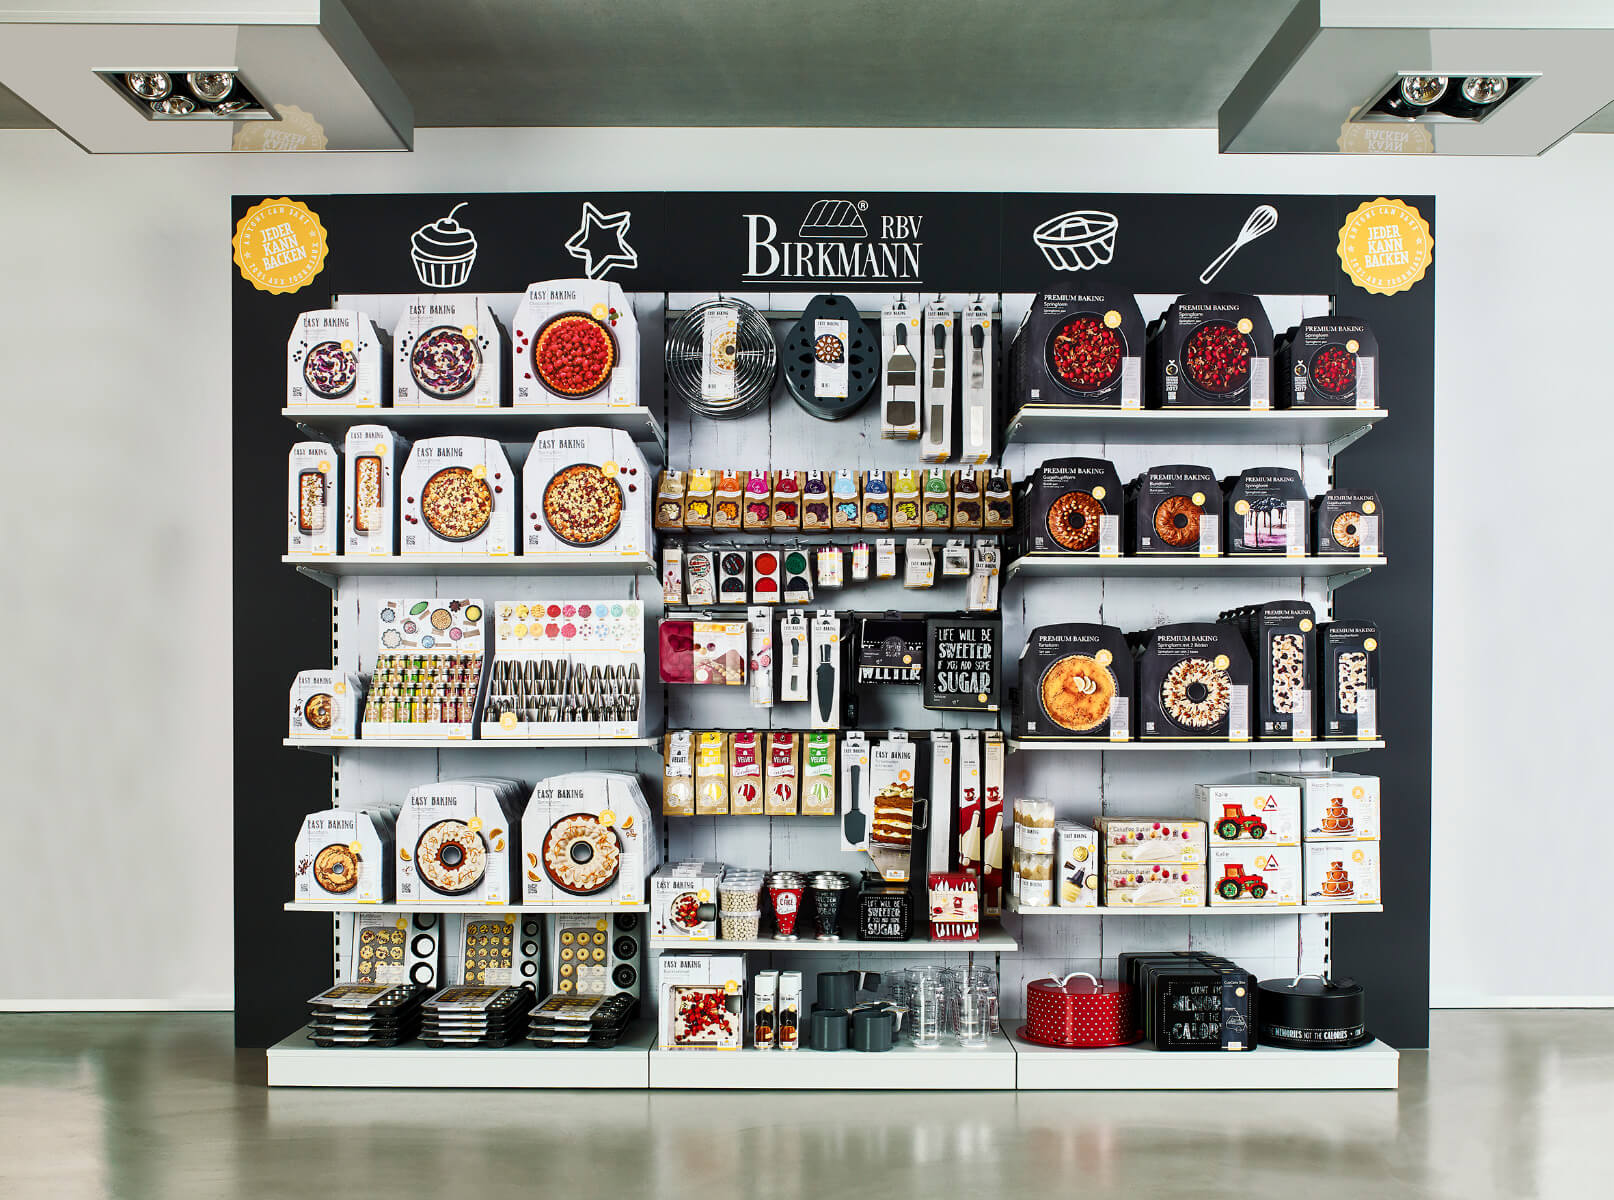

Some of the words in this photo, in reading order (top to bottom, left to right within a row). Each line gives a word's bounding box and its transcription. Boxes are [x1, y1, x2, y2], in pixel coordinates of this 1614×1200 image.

[880, 215, 923, 239] RBV
[260, 222, 294, 243] JEDER
[1367, 224, 1401, 241] JEDER
[262, 233, 299, 256] KANN
[741, 213, 924, 279] BIRKMANN
[1367, 237, 1404, 255] KANN
[262, 245, 307, 271] BACKEN
[1364, 250, 1409, 268] BACKEN
[529, 290, 547, 301] EASY
[550, 290, 577, 301] BAKING
[1043, 294, 1078, 302] PREMIUM
[409, 305, 425, 315] EASY
[429, 305, 456, 315] BAKING
[303, 318, 320, 328] EASY
[323, 317, 350, 328] BAKING
[538, 440, 556, 449] EASY
[559, 440, 585, 449] BAKING
[416, 447, 433, 457] EASY
[437, 447, 463, 457] BAKING
[1043, 467, 1076, 475] PREMIUM
[1077, 467, 1105, 475] BAKING
[938, 628, 955, 641] LIFE
[959, 628, 977, 641] WILL
[981, 628, 993, 641] BE
[1039, 635, 1072, 643] PREMIUM
[1072, 635, 1100, 643] BAKING
[938, 642, 992, 659] SWEETER
[974, 660, 991, 670] SOME
[299, 676, 311, 685] EASY
[313, 676, 332, 685] BAKING
[937, 671, 991, 693] SUGAR
[875, 750, 888, 759] EASY
[890, 751, 911, 760] BAKING
[537, 789, 554, 799] EASY
[557, 789, 584, 799] BAKING
[411, 796, 428, 806] EASY
[431, 796, 457, 806] BAKING
[307, 820, 324, 829] EASY
[327, 820, 354, 830] BAKING
[656, 881, 670, 889] EASY
[672, 881, 695, 889] BAKING
[880, 900, 891, 908] WILL
[893, 900, 900, 908] BE
[867, 908, 901, 917] SWEETER
[867, 923, 901, 936] SUGAR
[663, 960, 677, 968] EASY
[680, 960, 702, 969] BAKING
[1274, 1026, 1303, 1039] MEMORIES
[1303, 1031, 1312, 1039] NOT
[1314, 1031, 1323, 1039] THE
[1323, 1030, 1348, 1040] CALORIES
